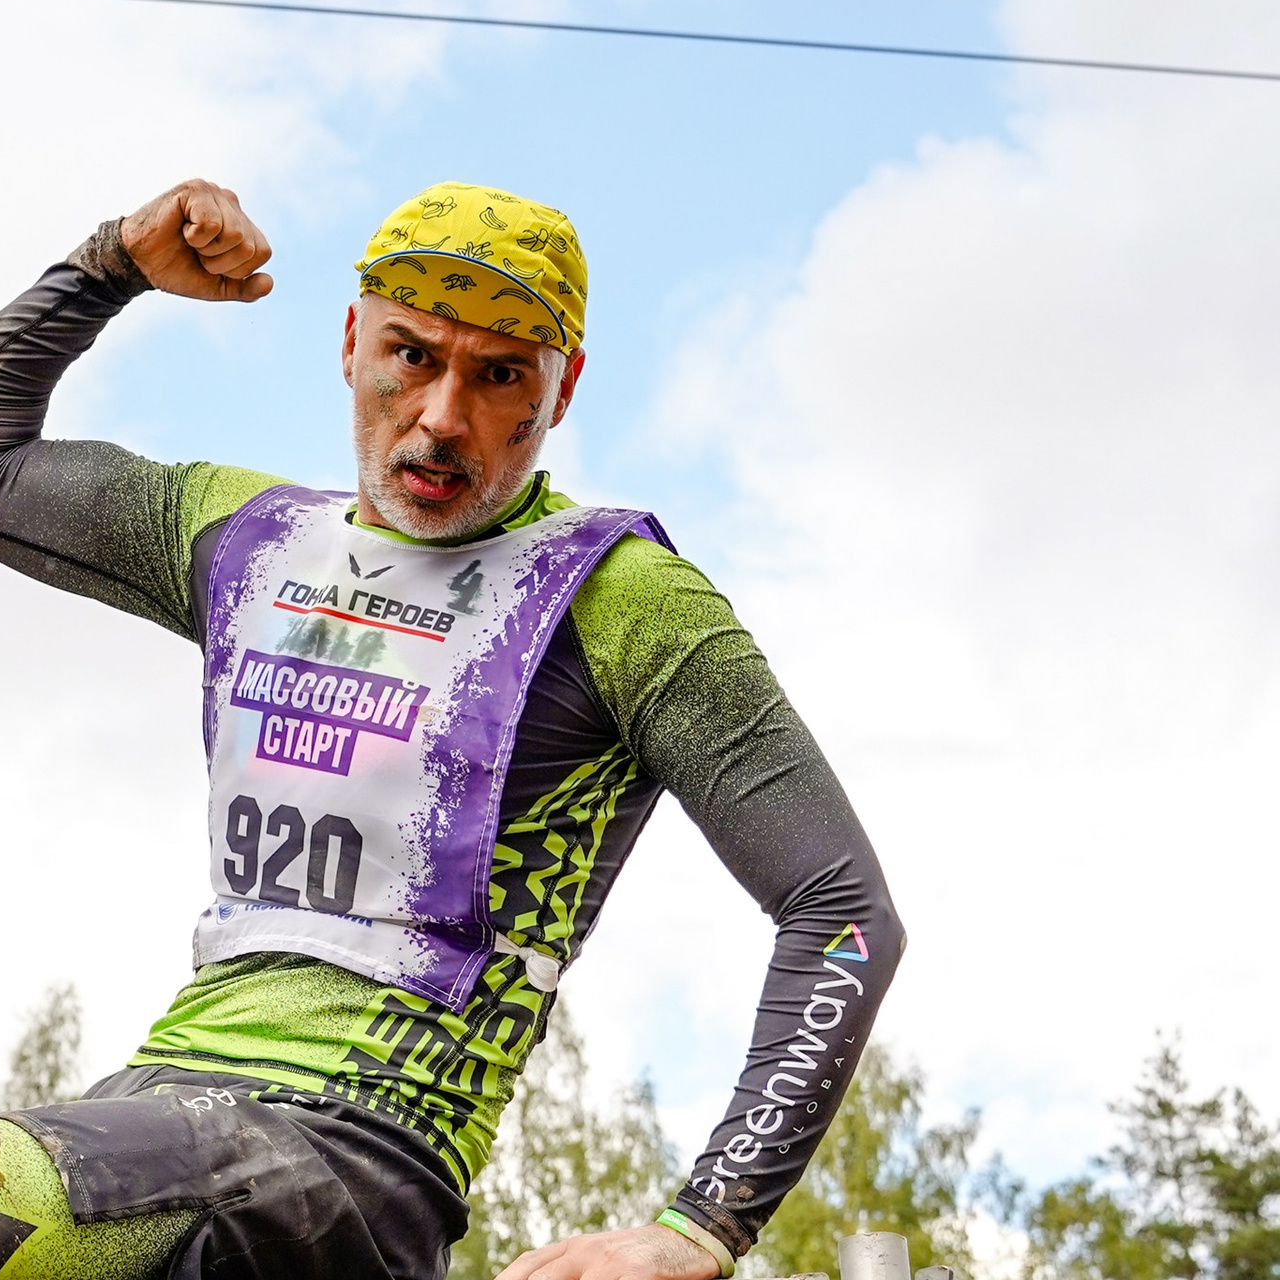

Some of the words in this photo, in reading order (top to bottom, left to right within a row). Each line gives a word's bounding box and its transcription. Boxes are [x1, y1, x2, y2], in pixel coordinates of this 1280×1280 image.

[347, 588, 456, 634] ГЕРОЕВ
[236, 659, 421, 730] МАССОВЫЙ
[262, 714, 352, 769] СТАРТ
[223, 794, 363, 914] 920
[777, 1034, 856, 1155] GLOBAL
